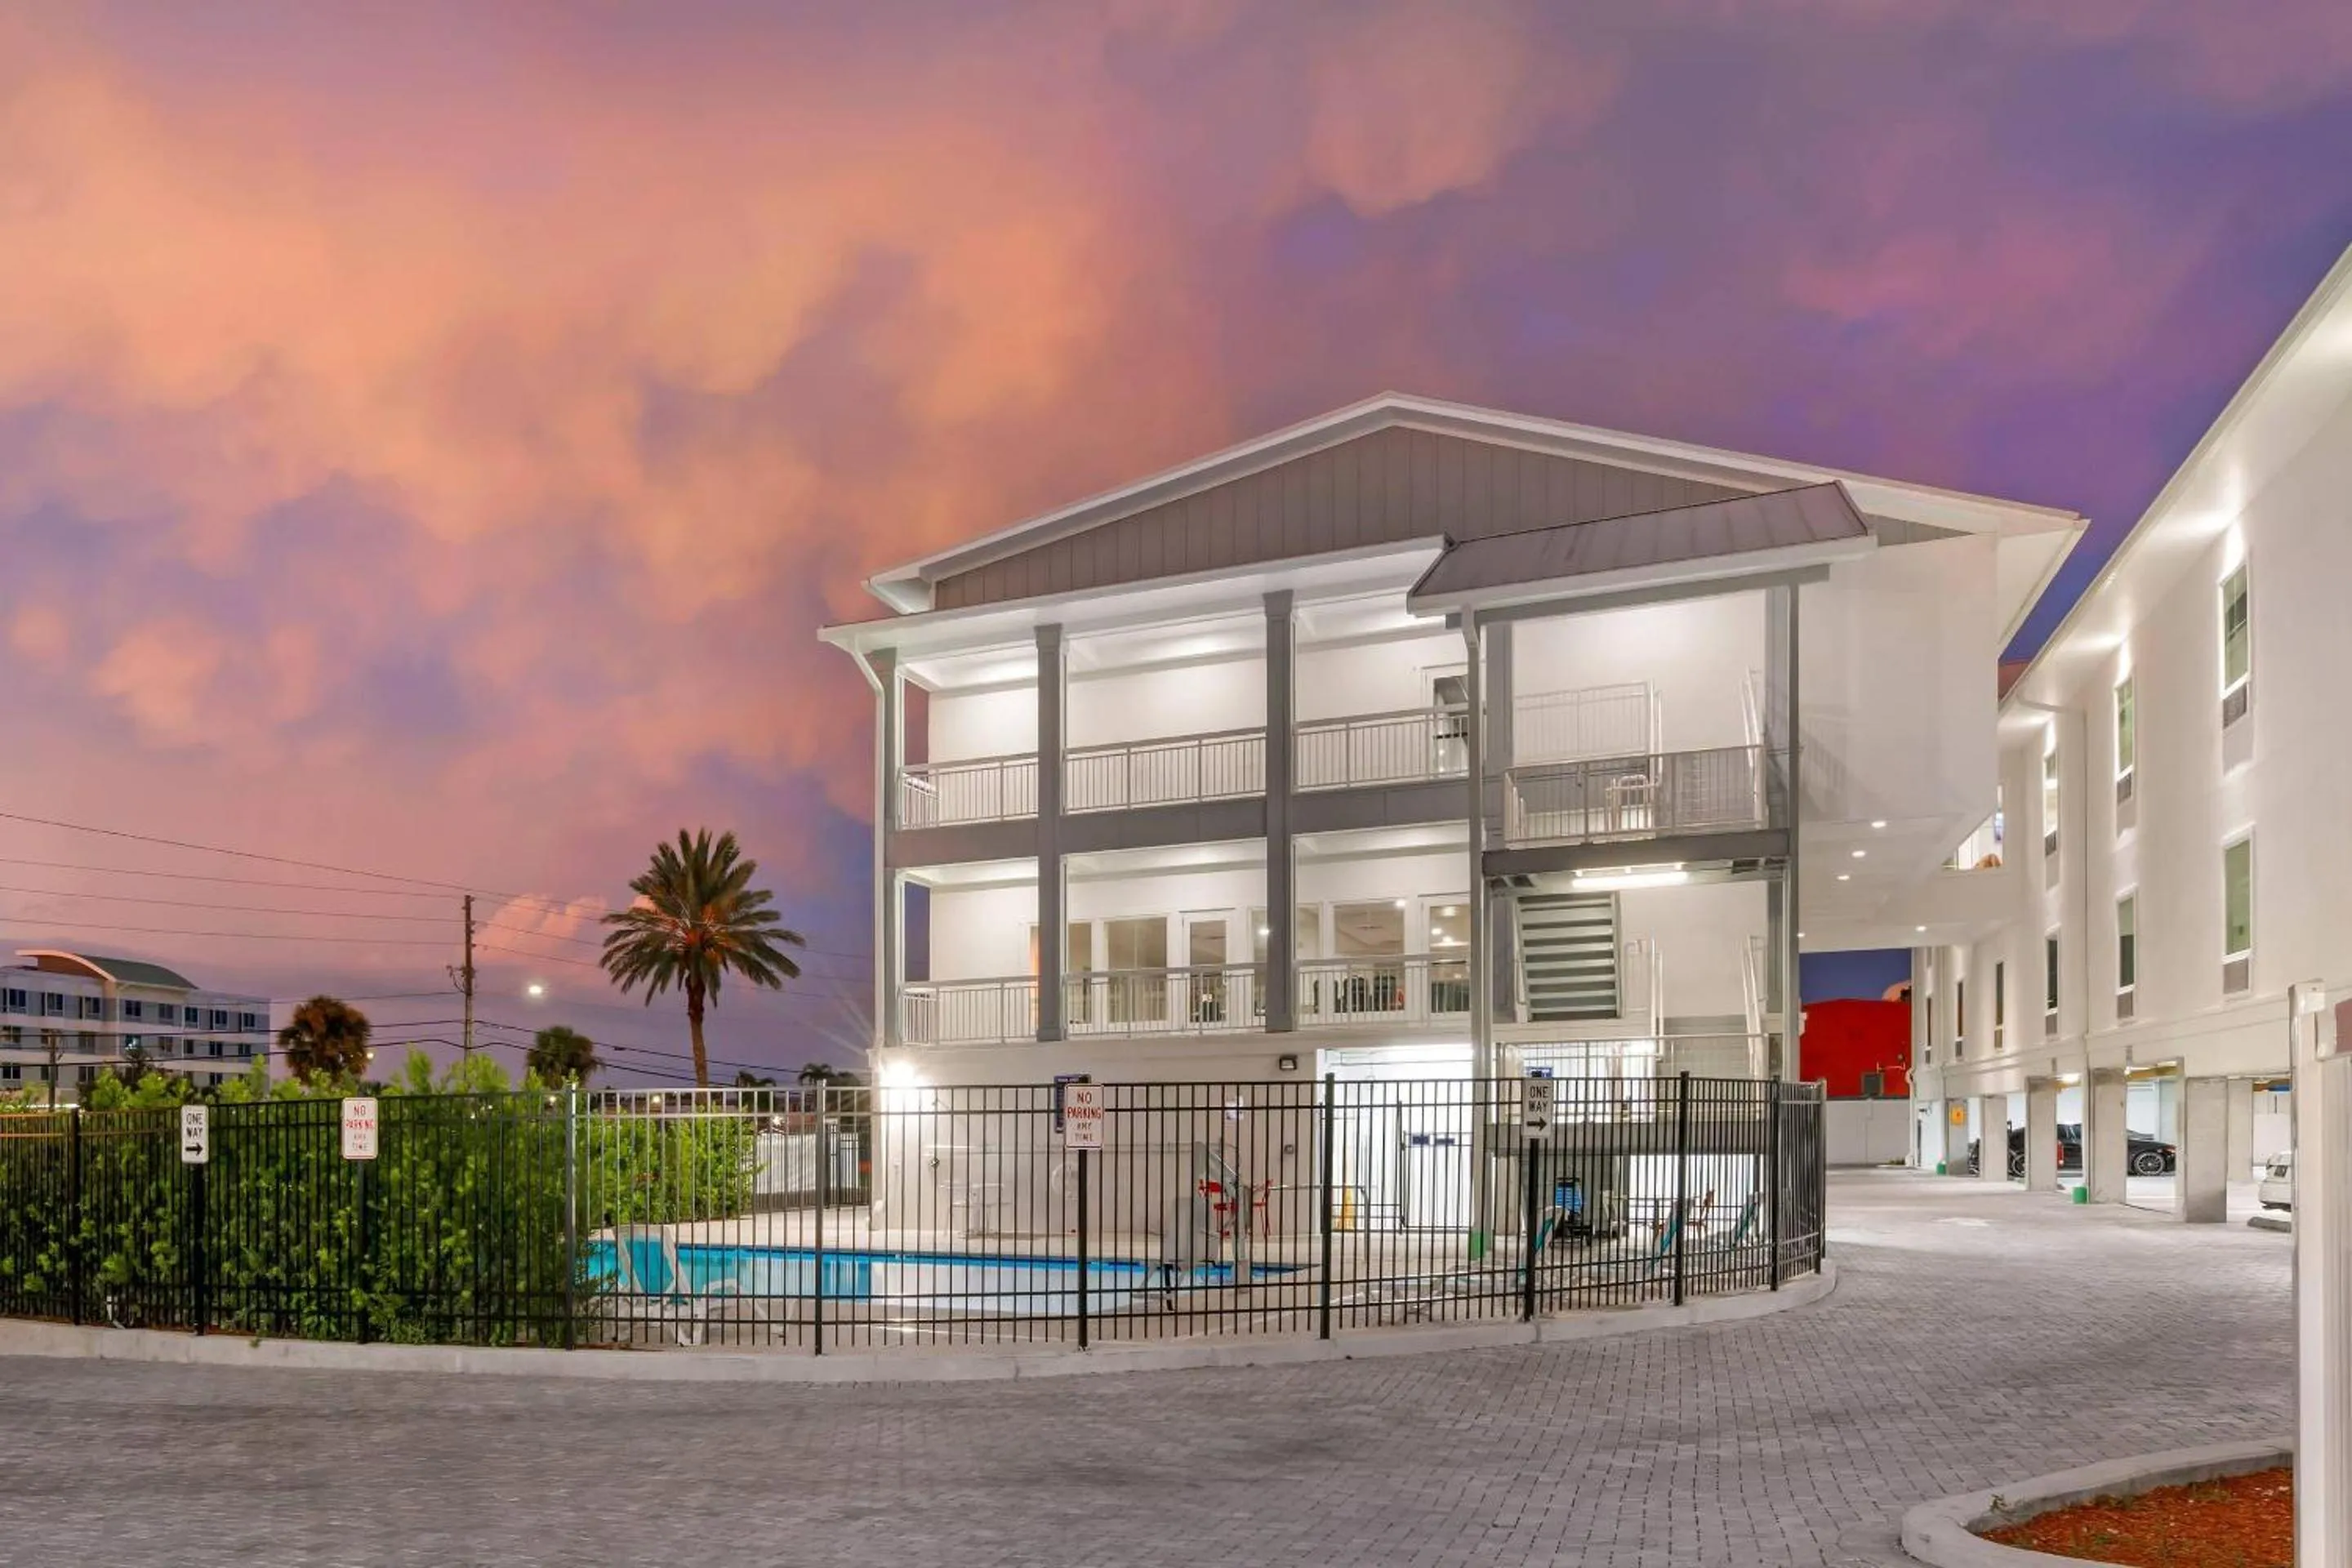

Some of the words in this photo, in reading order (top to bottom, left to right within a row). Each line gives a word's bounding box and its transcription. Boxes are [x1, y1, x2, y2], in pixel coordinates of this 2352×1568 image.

[1076, 1090, 1092, 1104] NO
[1530, 1085, 1549, 1098] ONE
[354, 1104, 366, 1116] NO
[1528, 1099, 1548, 1111] WAY
[186, 1112, 203, 1125] ONE
[1067, 1106, 1102, 1119] PARKING
[186, 1127, 203, 1138] WAY
